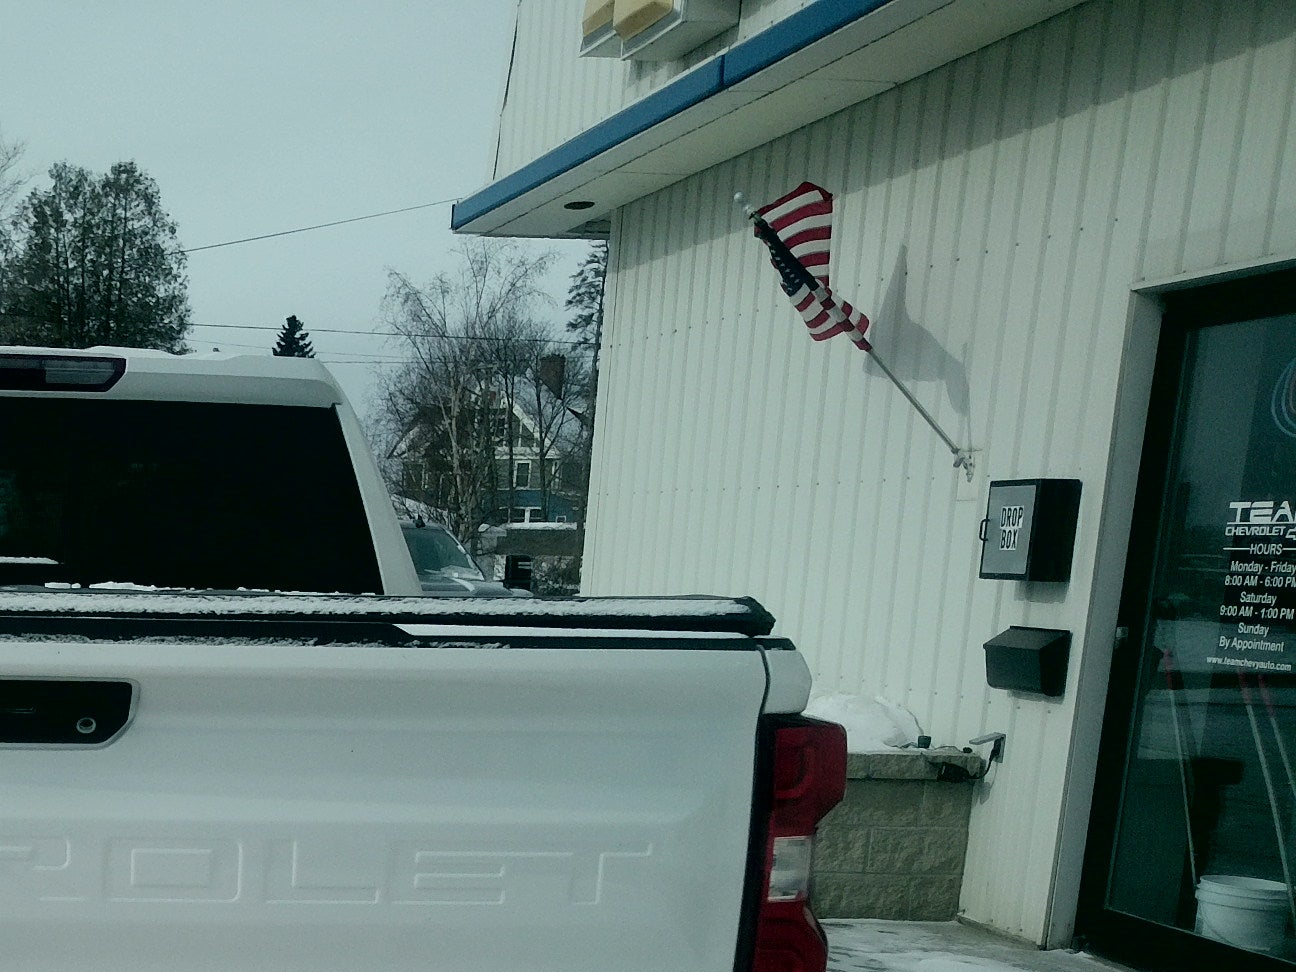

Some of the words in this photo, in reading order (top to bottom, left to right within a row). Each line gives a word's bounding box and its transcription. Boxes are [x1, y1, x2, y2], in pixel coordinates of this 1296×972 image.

[1001, 506, 1024, 527] DROP
[1229, 501, 1296, 522] TEA
[1000, 529, 1018, 549] BOX
[1225, 526, 1286, 536] CHEVROLET
[1249, 543, 1283, 555] HOURS
[1230, 560, 1263, 575] Monday
[1270, 561, 1296, 576] Friday
[1224, 574, 1243, 586] 8:00
[1244, 575, 1259, 586] AM
[1264, 576, 1284, 587] 6:00
[1239, 591, 1278, 607] Saturday
[1219, 605, 1238, 617] 9:00
[1238, 606, 1254, 617] AM
[1260, 607, 1279, 619] 1:00
[1279, 608, 1295, 620] PM
[1237, 622, 1270, 638] Sunday
[1219, 635, 1231, 650] By
[1231, 637, 1285, 652] Appointment
[1206, 656, 1292, 671] www.teamchevyauto.com
